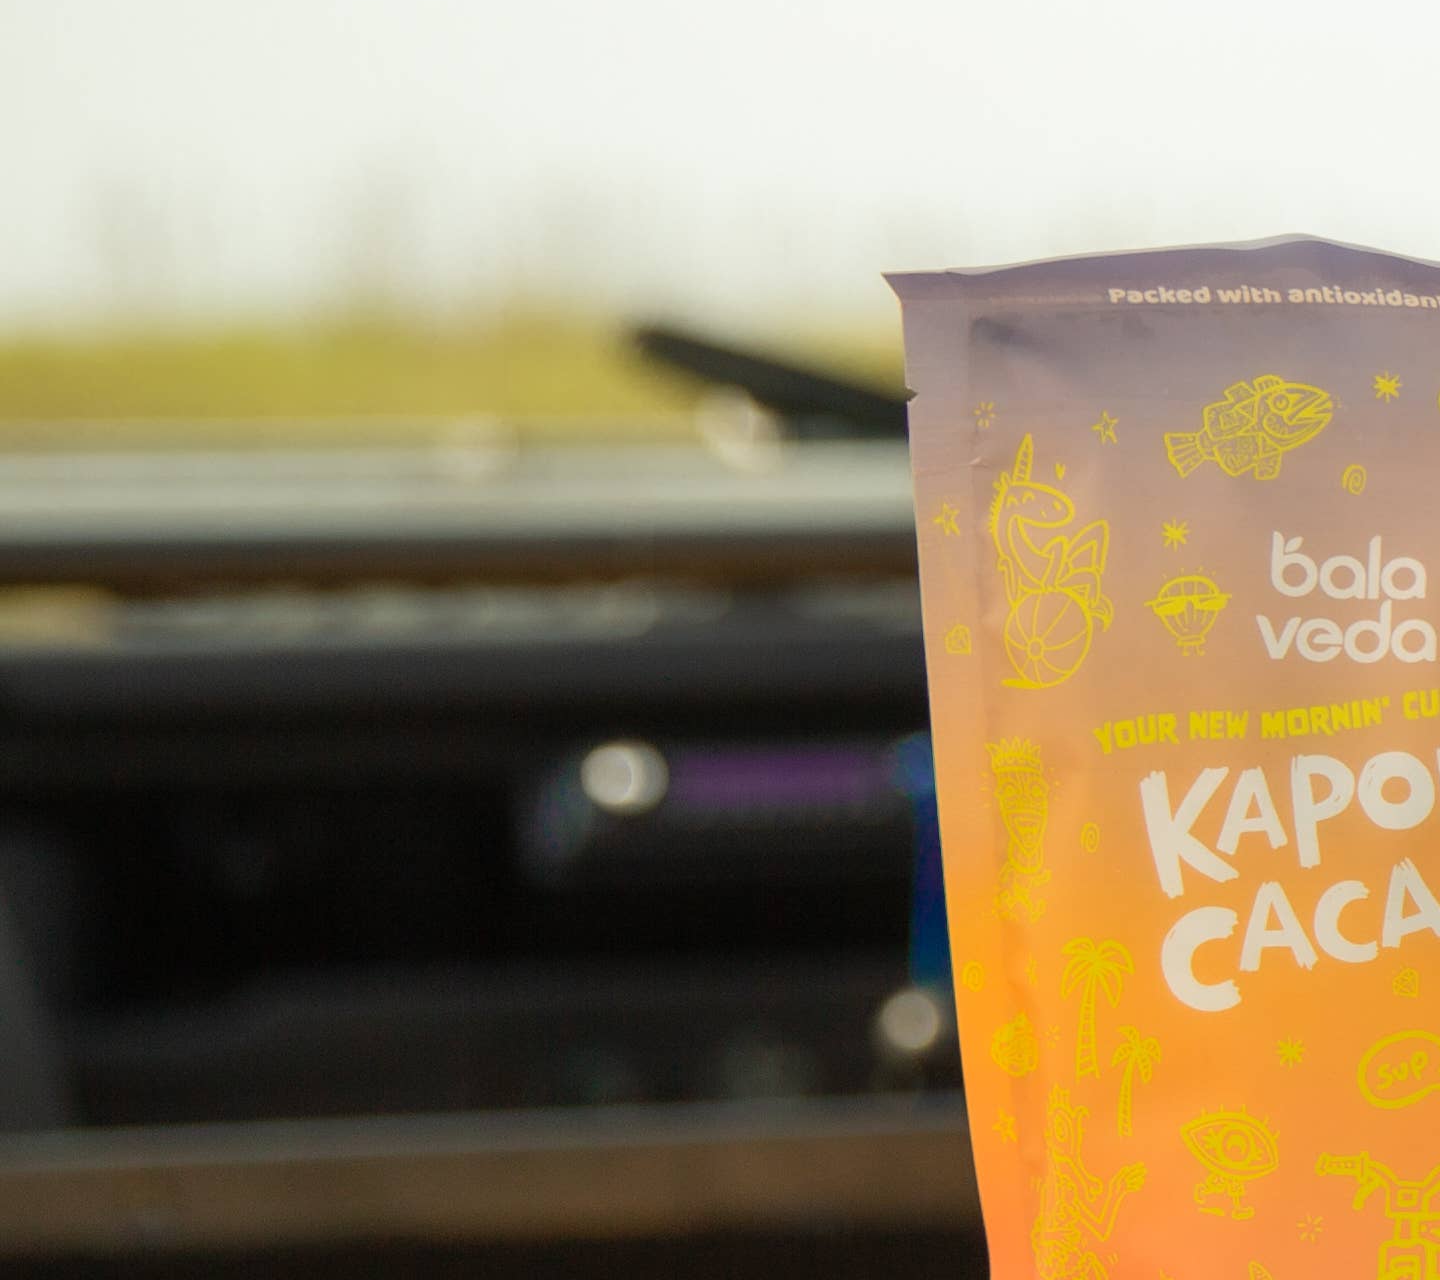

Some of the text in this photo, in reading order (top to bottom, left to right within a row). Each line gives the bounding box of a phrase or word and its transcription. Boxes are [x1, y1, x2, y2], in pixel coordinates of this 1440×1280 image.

[1108, 285, 1212, 305] Packed
[1216, 284, 1283, 305] with
[1270, 530, 1427, 601] bala
[1255, 598, 1438, 664] veda
[1092, 712, 1181, 755] YOUR
[1188, 709, 1250, 741] NEW
[1259, 695, 1391, 740] MORNIN'
